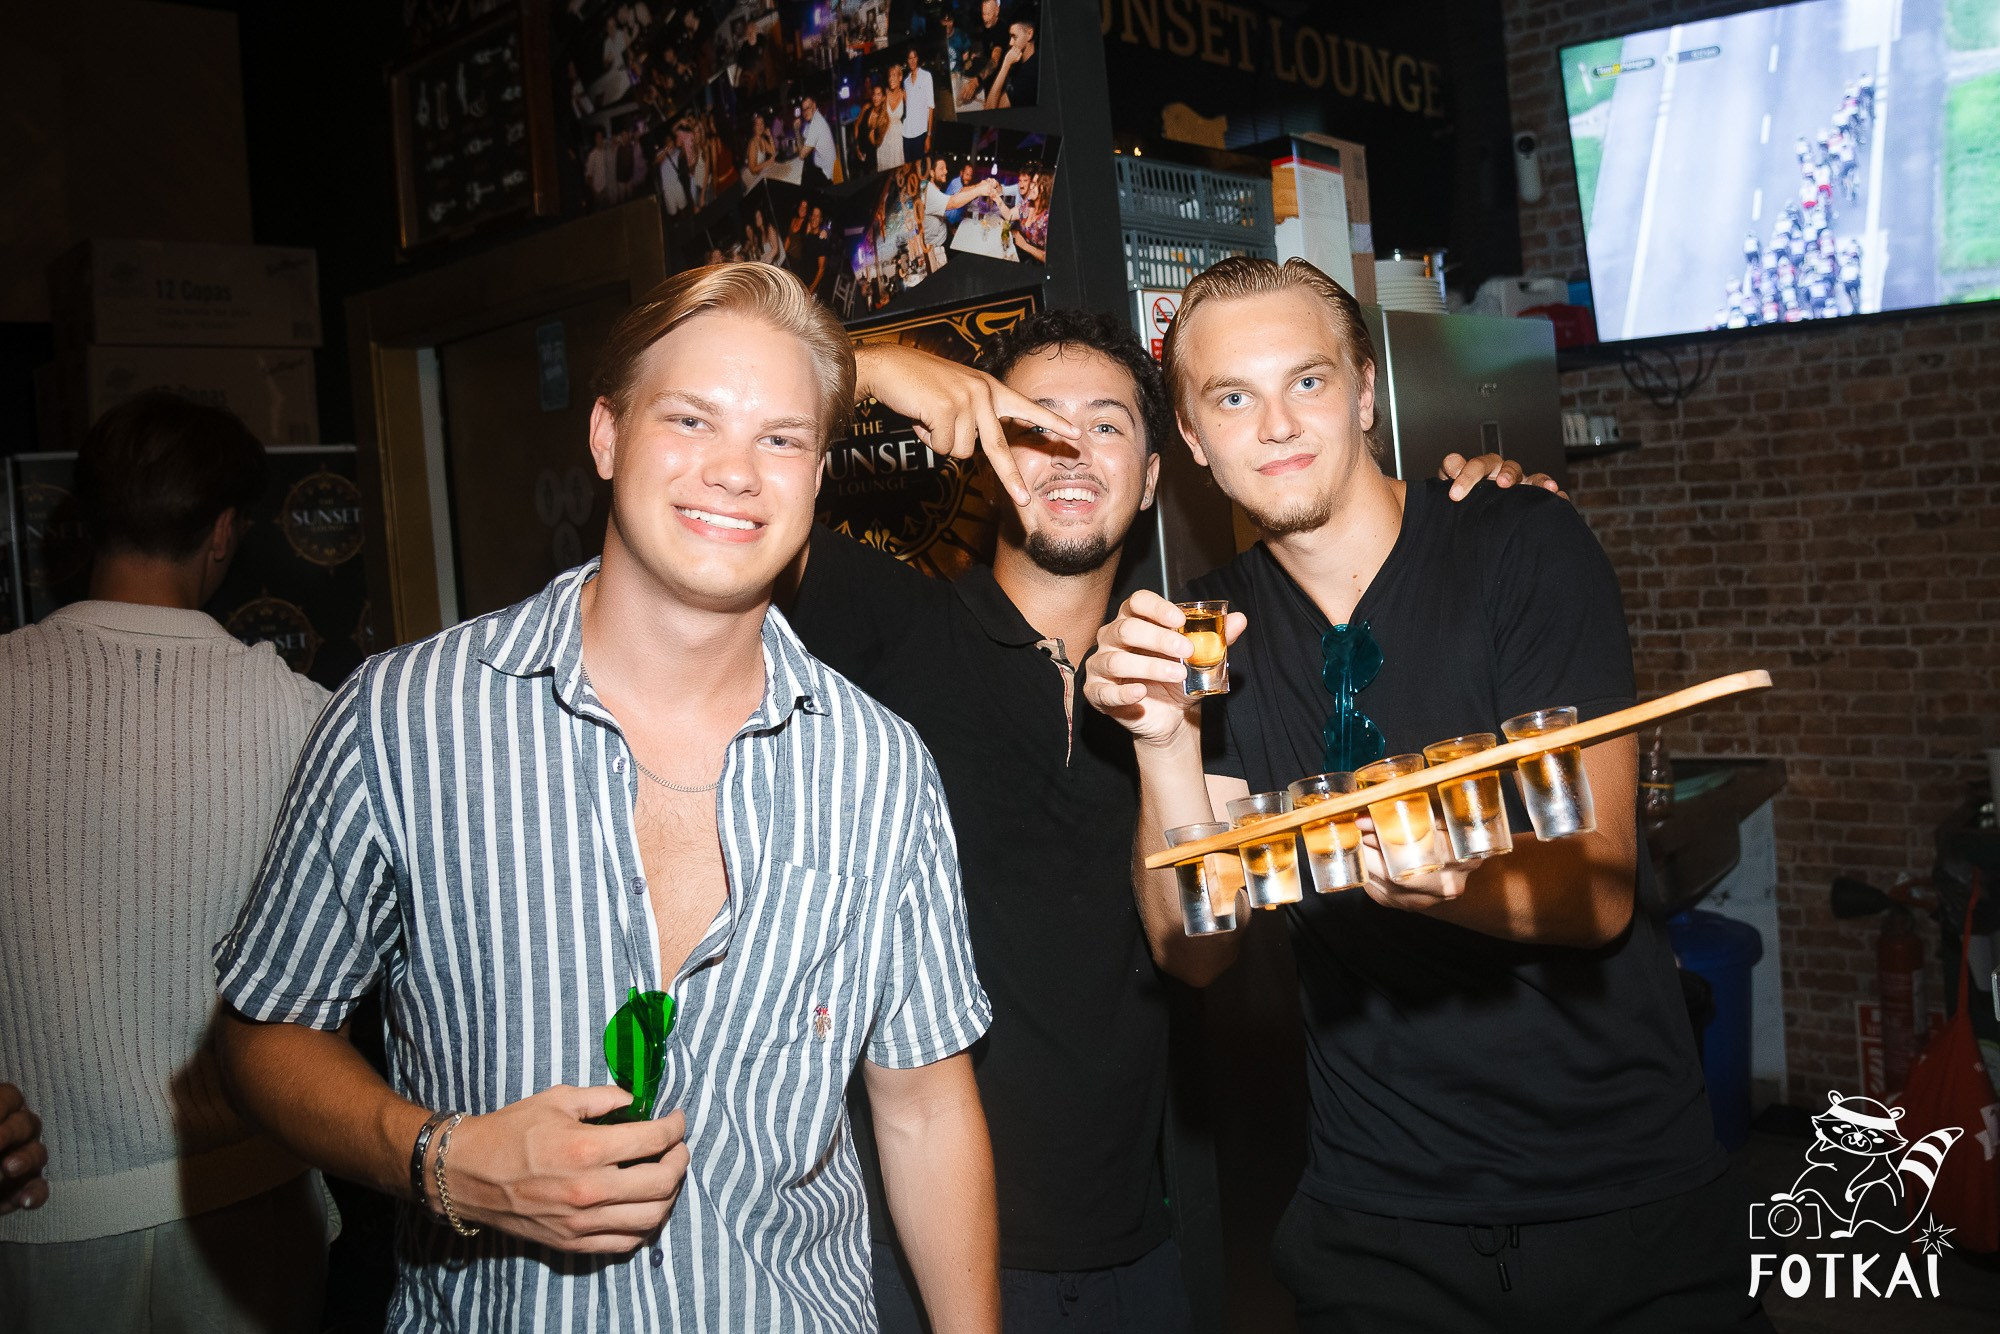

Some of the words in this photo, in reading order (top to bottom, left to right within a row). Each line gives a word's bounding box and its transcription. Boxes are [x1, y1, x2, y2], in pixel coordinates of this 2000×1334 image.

[1100, 0, 1257, 73] NSET
[1267, 16, 1444, 120] LOUNGE
[180, 279, 233, 304] Copas
[852, 419, 884, 437] THE
[825, 439, 936, 481] UNSET
[837, 475, 909, 497] LOUNGE
[291, 506, 362, 526] SUNSET
